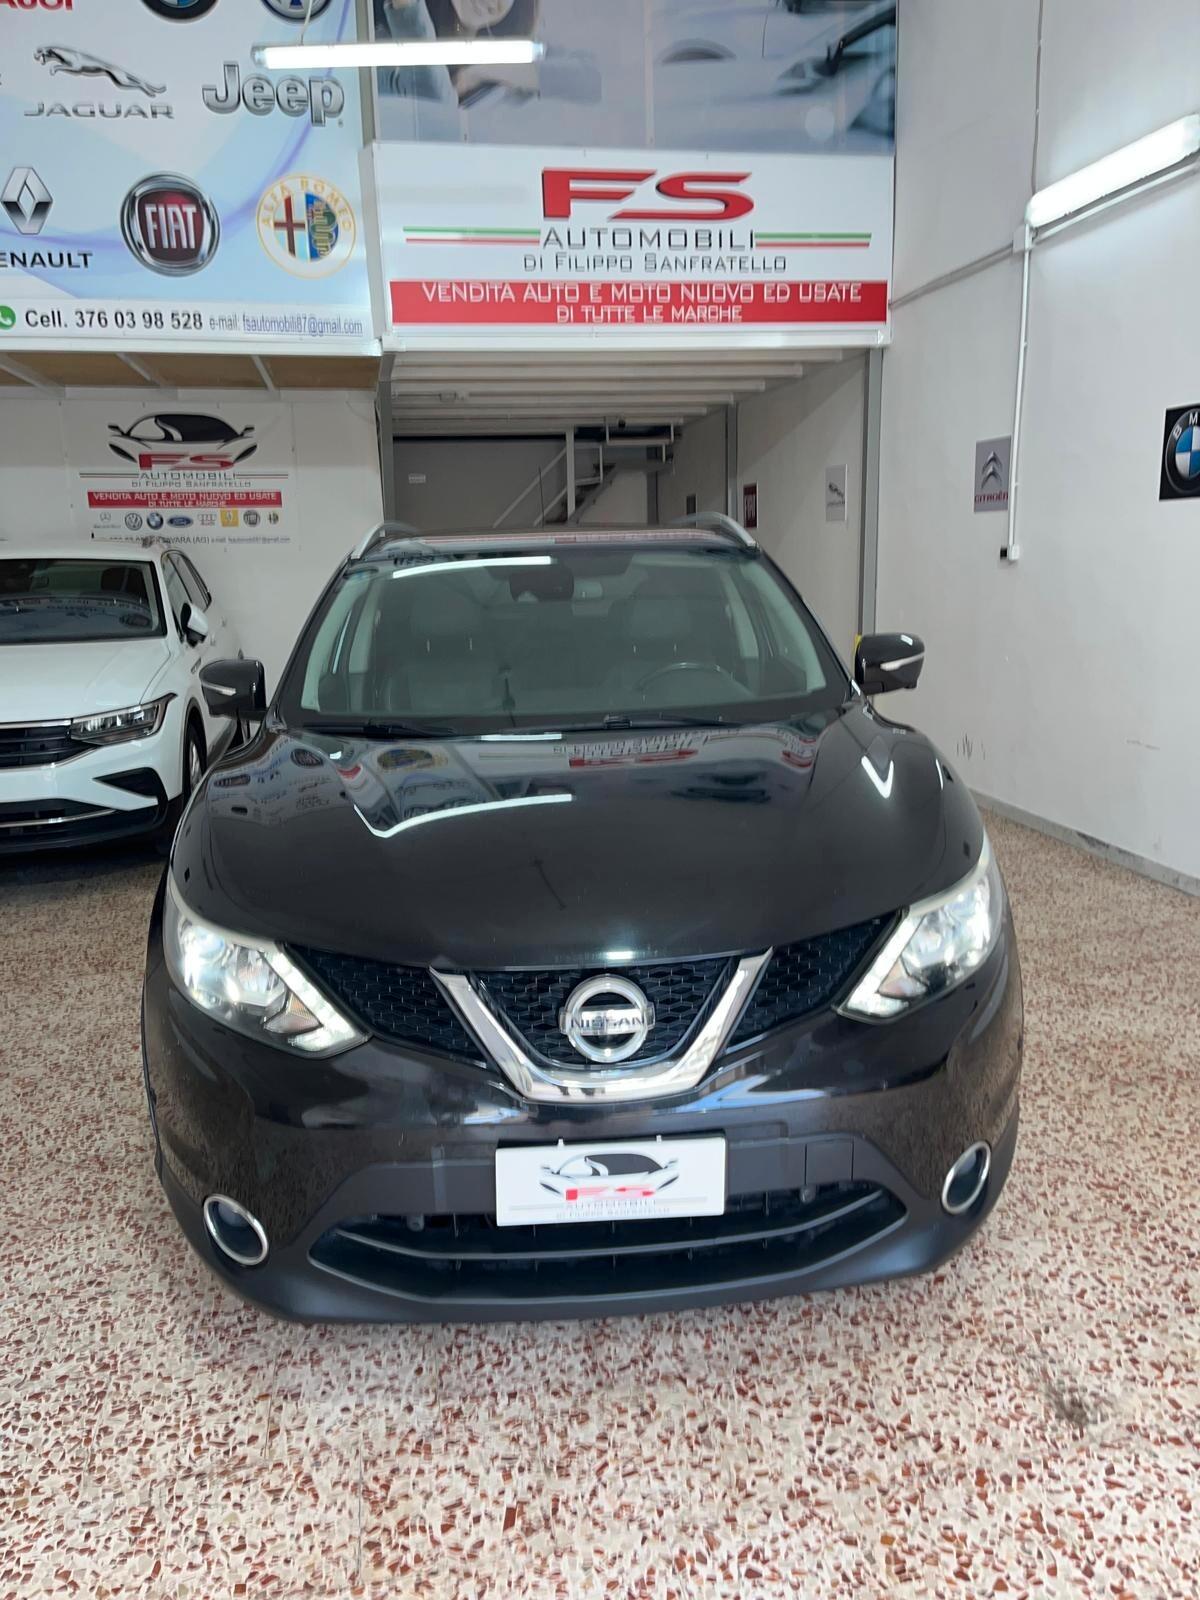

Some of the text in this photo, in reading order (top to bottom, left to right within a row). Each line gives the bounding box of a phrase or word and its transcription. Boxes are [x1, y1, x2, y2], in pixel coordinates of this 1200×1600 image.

[202, 61, 345, 127] Jeep
[24, 102, 174, 119] JAGUAR
[542, 166, 754, 221] FS
[144, 203, 197, 249] FIAT
[543, 227, 754, 250] AUTOMOBILI
[524, 251, 787, 273] DI FILIPPO SANFRATELLO
[421, 282, 861, 303] VENDITA AUTO E MOTO NUOVO ED USATE
[25, 310, 363, 337] Cell. 376 03 98 528 e-mail: fsautomobili87@gmail.com
[557, 305, 742, 323] DI TUTTE LE MARCHE
[139, 454, 234, 470] FS
[140, 472, 236, 480] AUTOMOBILI
[93, 492, 131, 501] VENDITA
[134, 492, 159, 501] AUTO
[170, 492, 196, 501] MOTO
[199, 493, 231, 501] NUOVO
[570, 1013, 646, 1029] NISSAN
